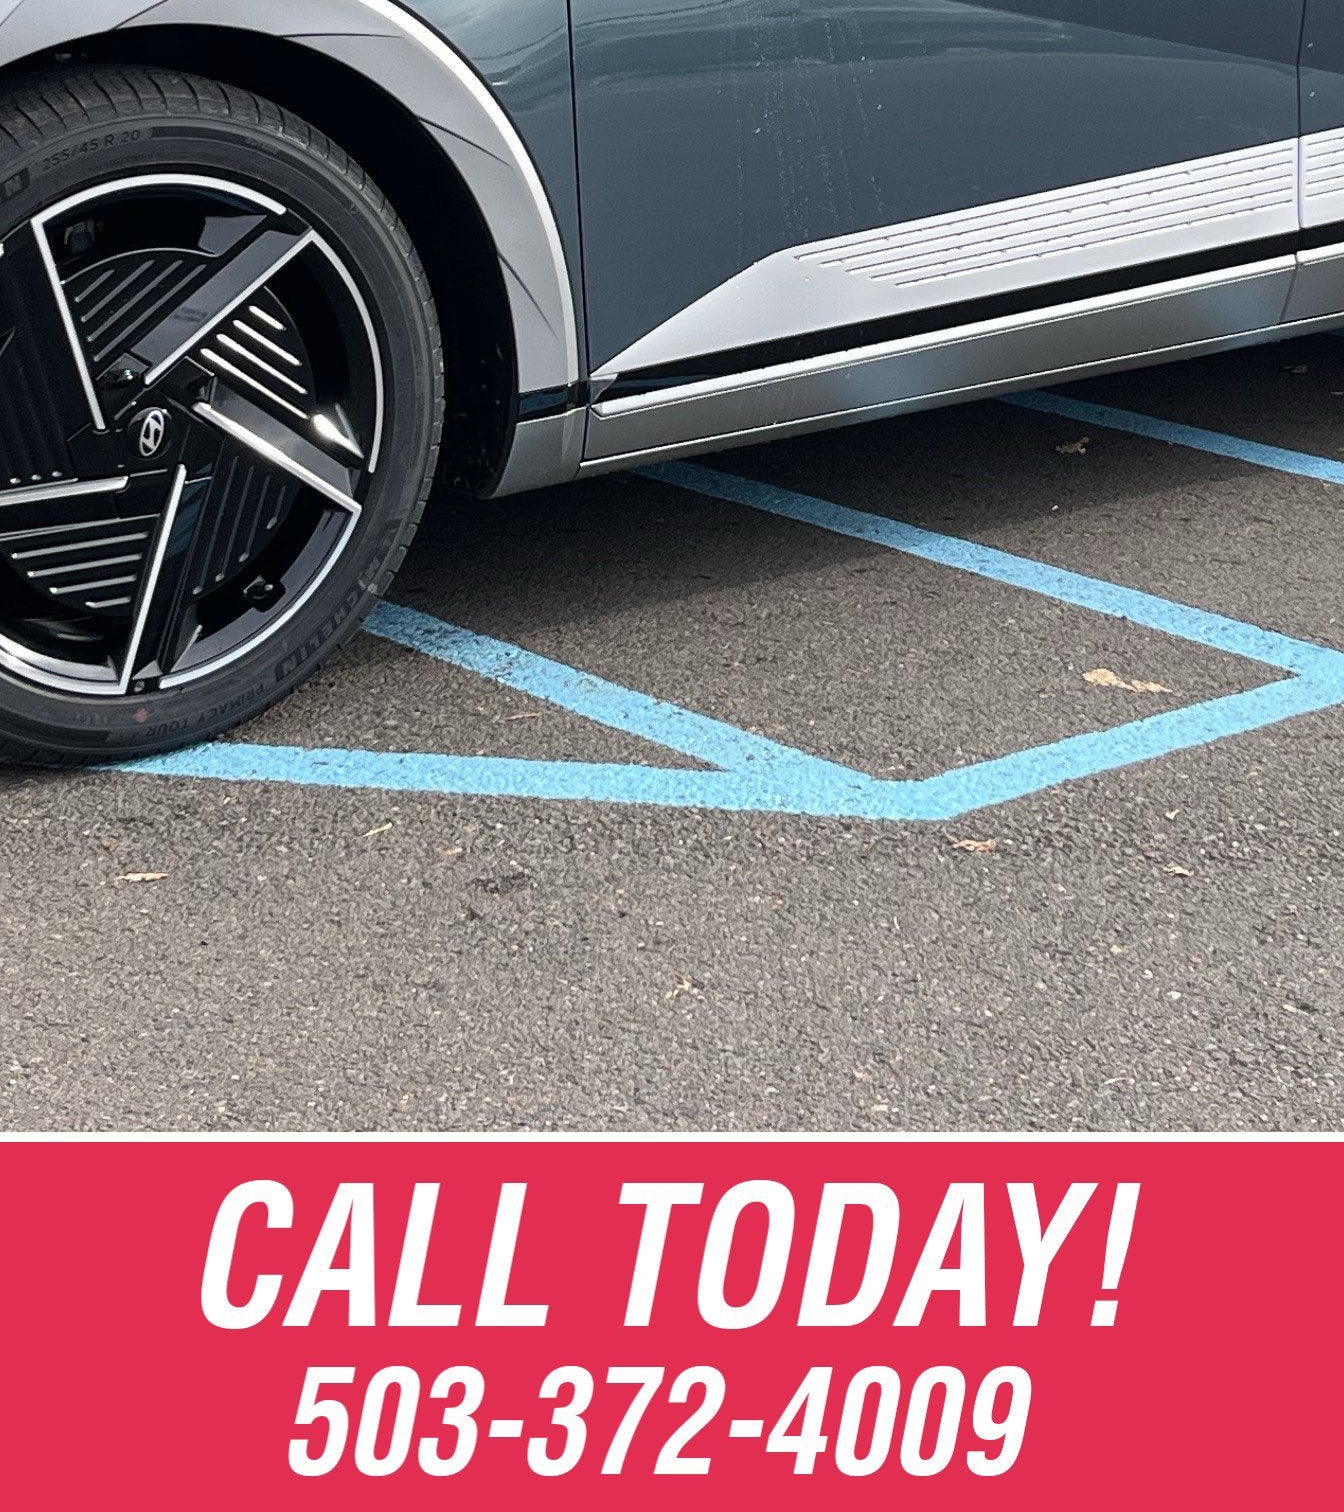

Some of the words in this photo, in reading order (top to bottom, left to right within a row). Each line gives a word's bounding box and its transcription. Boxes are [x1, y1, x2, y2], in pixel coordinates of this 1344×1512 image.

[41, 139, 98, 171] 255/45
[102, 133, 115, 146] R
[120, 128, 141, 143] 20
